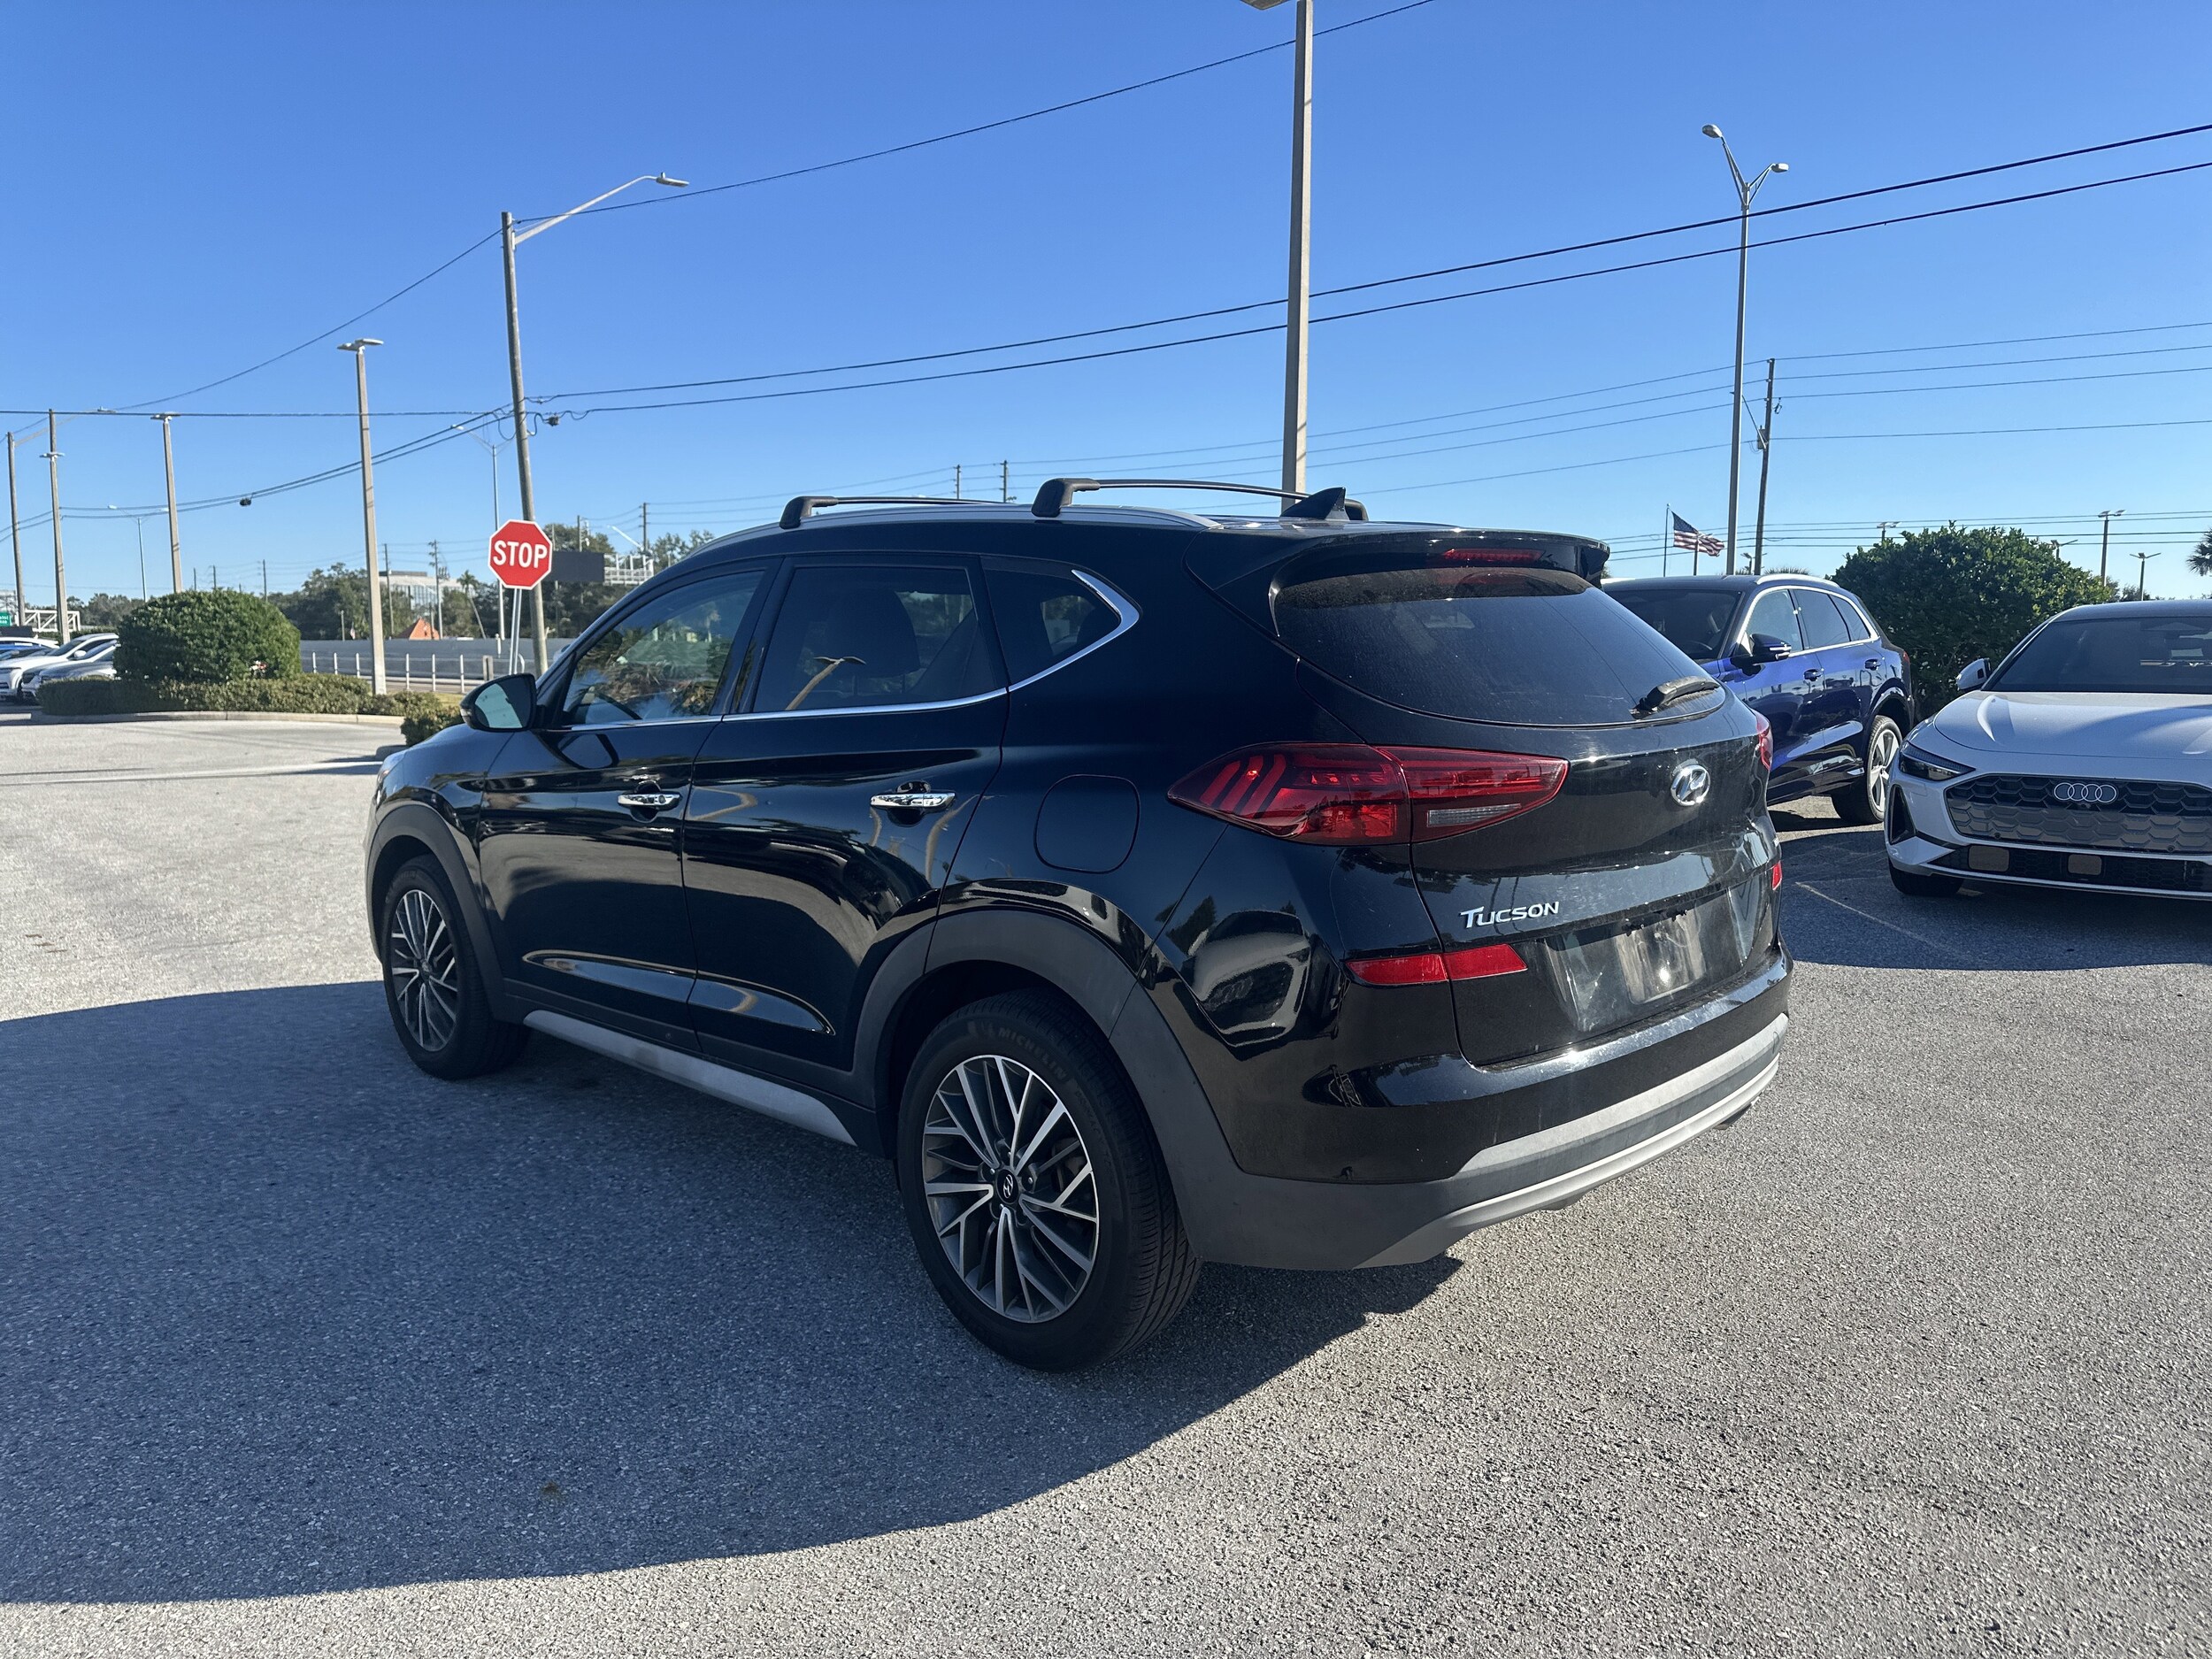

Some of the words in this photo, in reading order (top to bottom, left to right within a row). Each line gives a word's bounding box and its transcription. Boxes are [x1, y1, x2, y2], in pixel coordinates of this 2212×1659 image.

[493, 540, 548, 568] STOP
[1460, 902, 1560, 928] TUCSON
[997, 1026, 1068, 1080] MICHELIN
